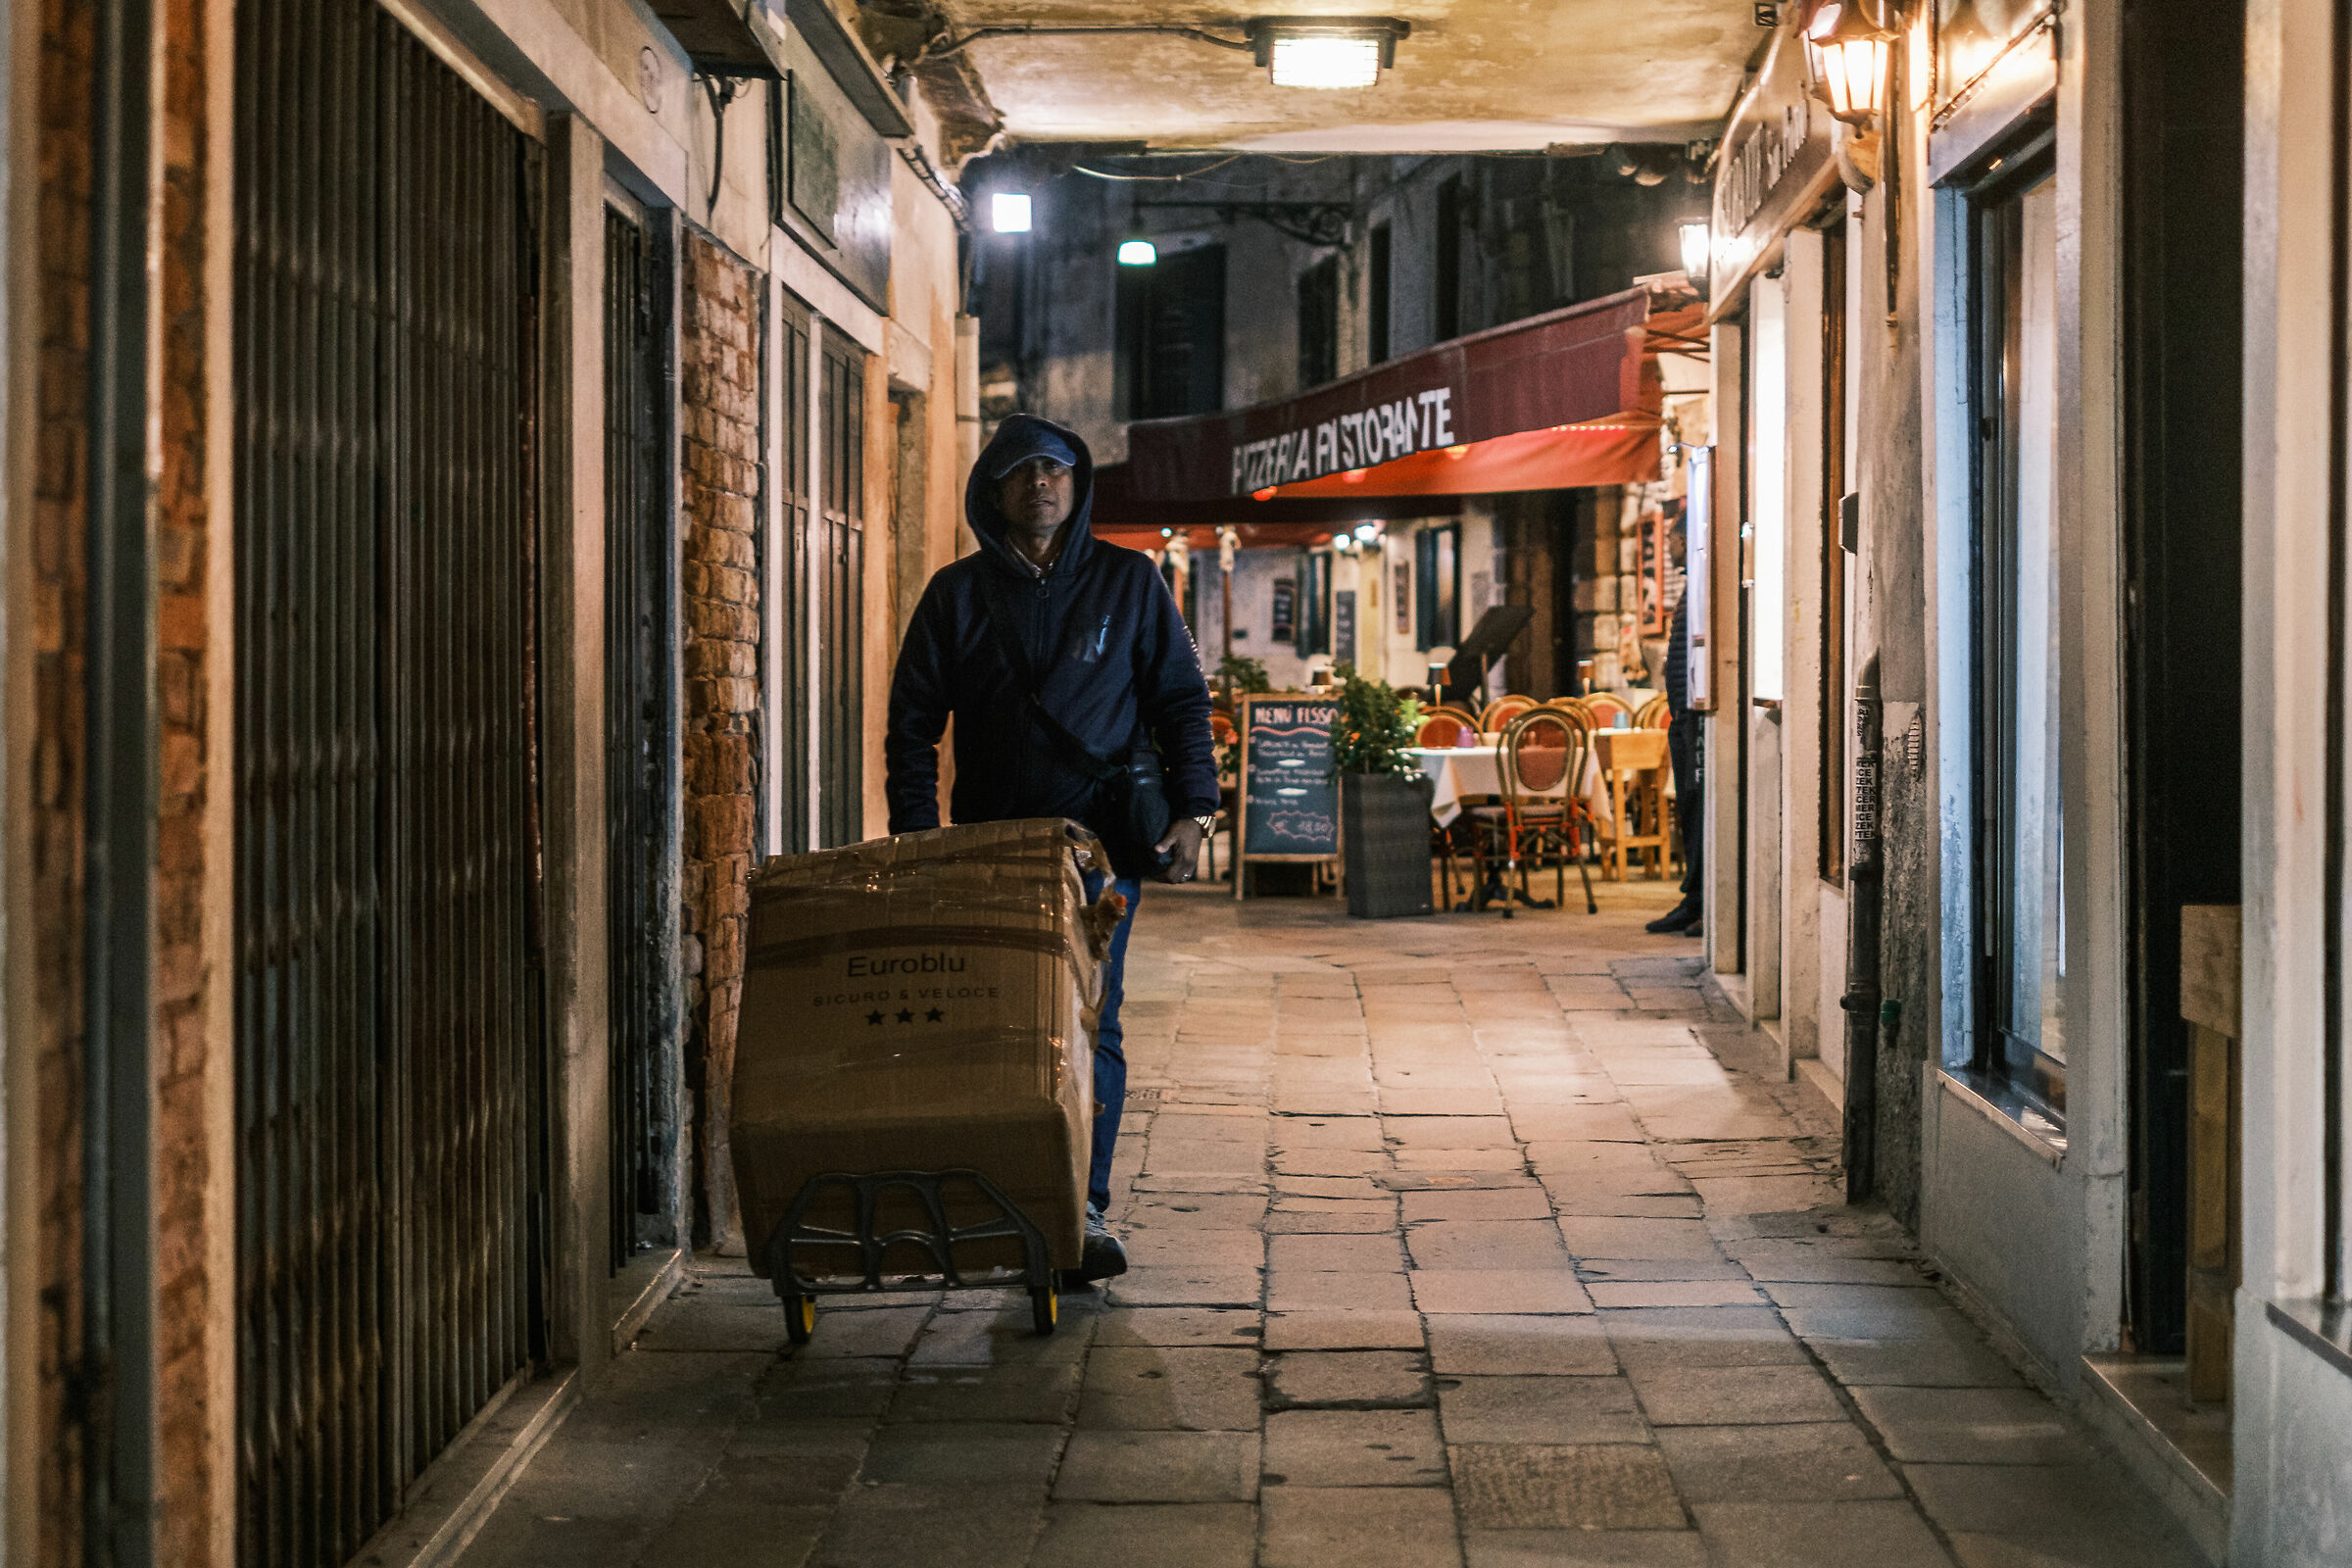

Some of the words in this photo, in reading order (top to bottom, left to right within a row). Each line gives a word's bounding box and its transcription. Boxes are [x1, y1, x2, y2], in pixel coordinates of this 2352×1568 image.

[848, 953, 965, 978] Euroblu
[813, 990, 890, 1007] SICURO
[899, 989, 909, 1001] &
[918, 986, 1001, 1001] VELOCE
